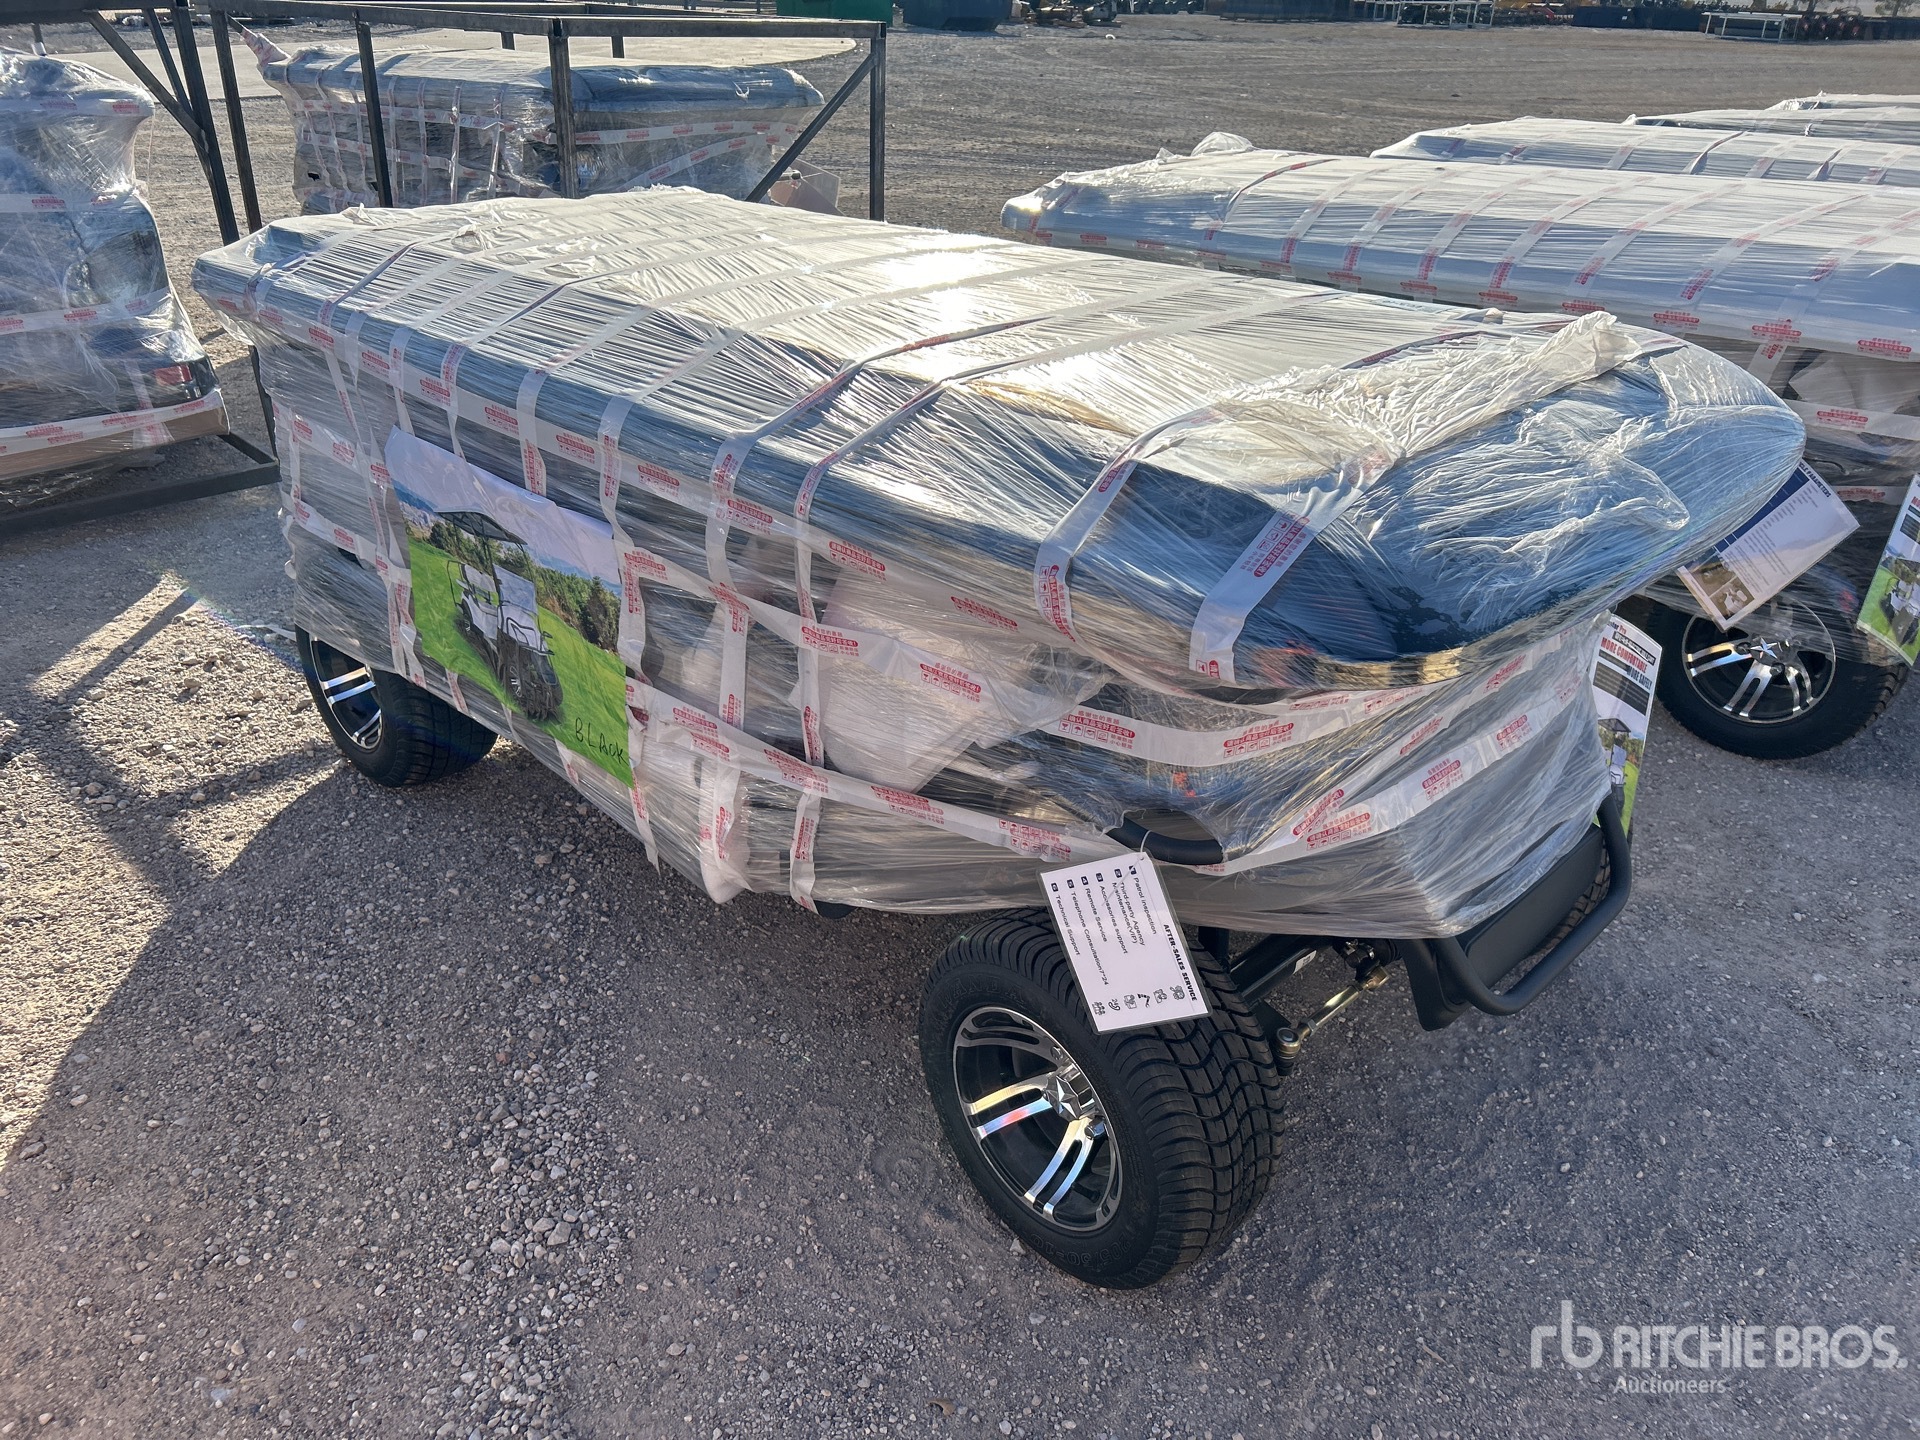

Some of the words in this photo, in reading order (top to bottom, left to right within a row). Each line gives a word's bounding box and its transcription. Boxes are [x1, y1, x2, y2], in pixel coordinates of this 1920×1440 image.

[1808, 470, 1831, 497] PARAMETERS
[1600, 637, 1616, 655] MORE
[1617, 643, 1648, 674] COMFORTABLE
[1071, 892, 1086, 928] Telephone
[1085, 888, 1098, 916] Remote
[1096, 915, 1108, 943] Service
[1134, 877, 1145, 903] Patrol
[1142, 899, 1157, 935] inspection
[1055, 894, 1071, 929] Technical
[1066, 926, 1081, 956] Support
[1115, 926, 1129, 955] support
[1132, 917, 1146, 946] Agency
[1163, 924, 1186, 970] AFTER-SALES
[1181, 970, 1198, 1001] SERVICE
